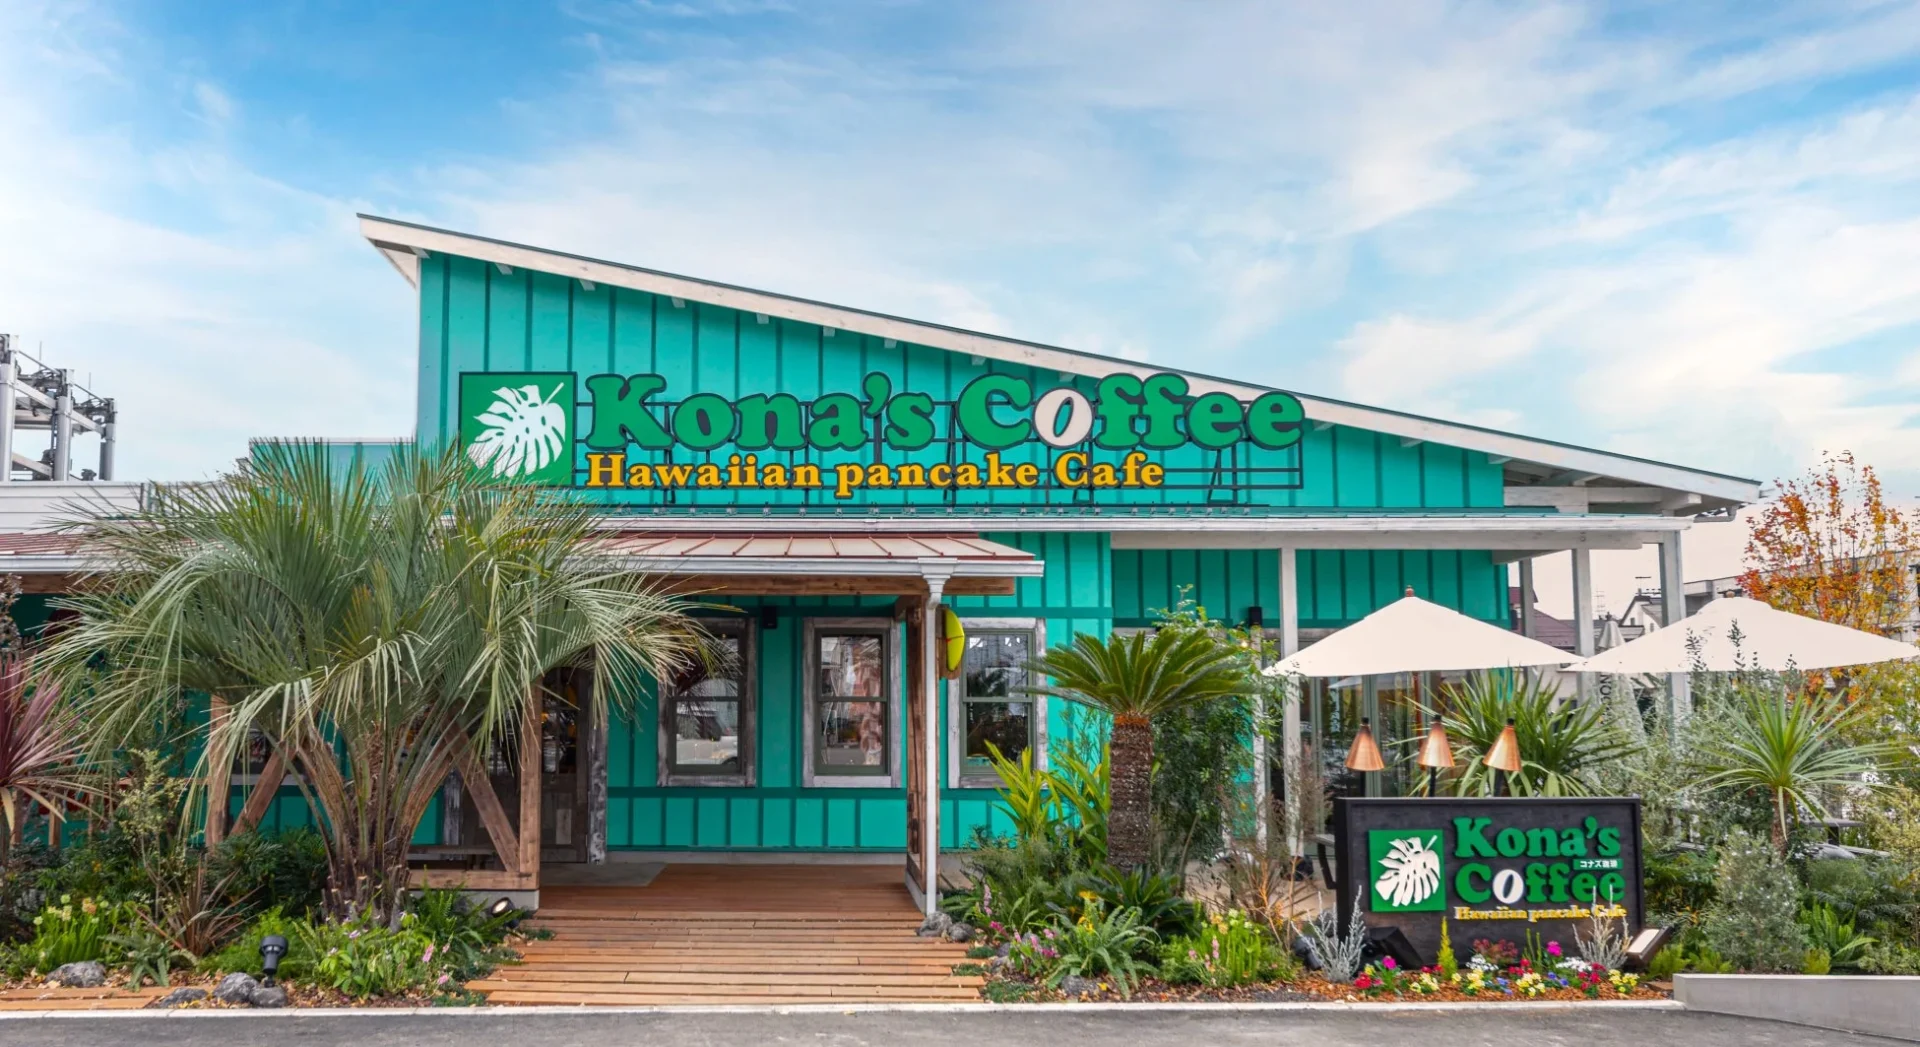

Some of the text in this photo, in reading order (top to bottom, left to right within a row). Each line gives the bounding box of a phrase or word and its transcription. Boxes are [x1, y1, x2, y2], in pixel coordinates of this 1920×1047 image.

[584, 371, 1305, 451] Kona's Coffee
[586, 452, 1164, 499] Hawaiian pancake Cafe
[1454, 816, 1621, 858] Kona's
[1455, 863, 1625, 904] Coffee
[1453, 906, 1528, 920] Hawaiian
[1528, 905, 1590, 922] pancake
